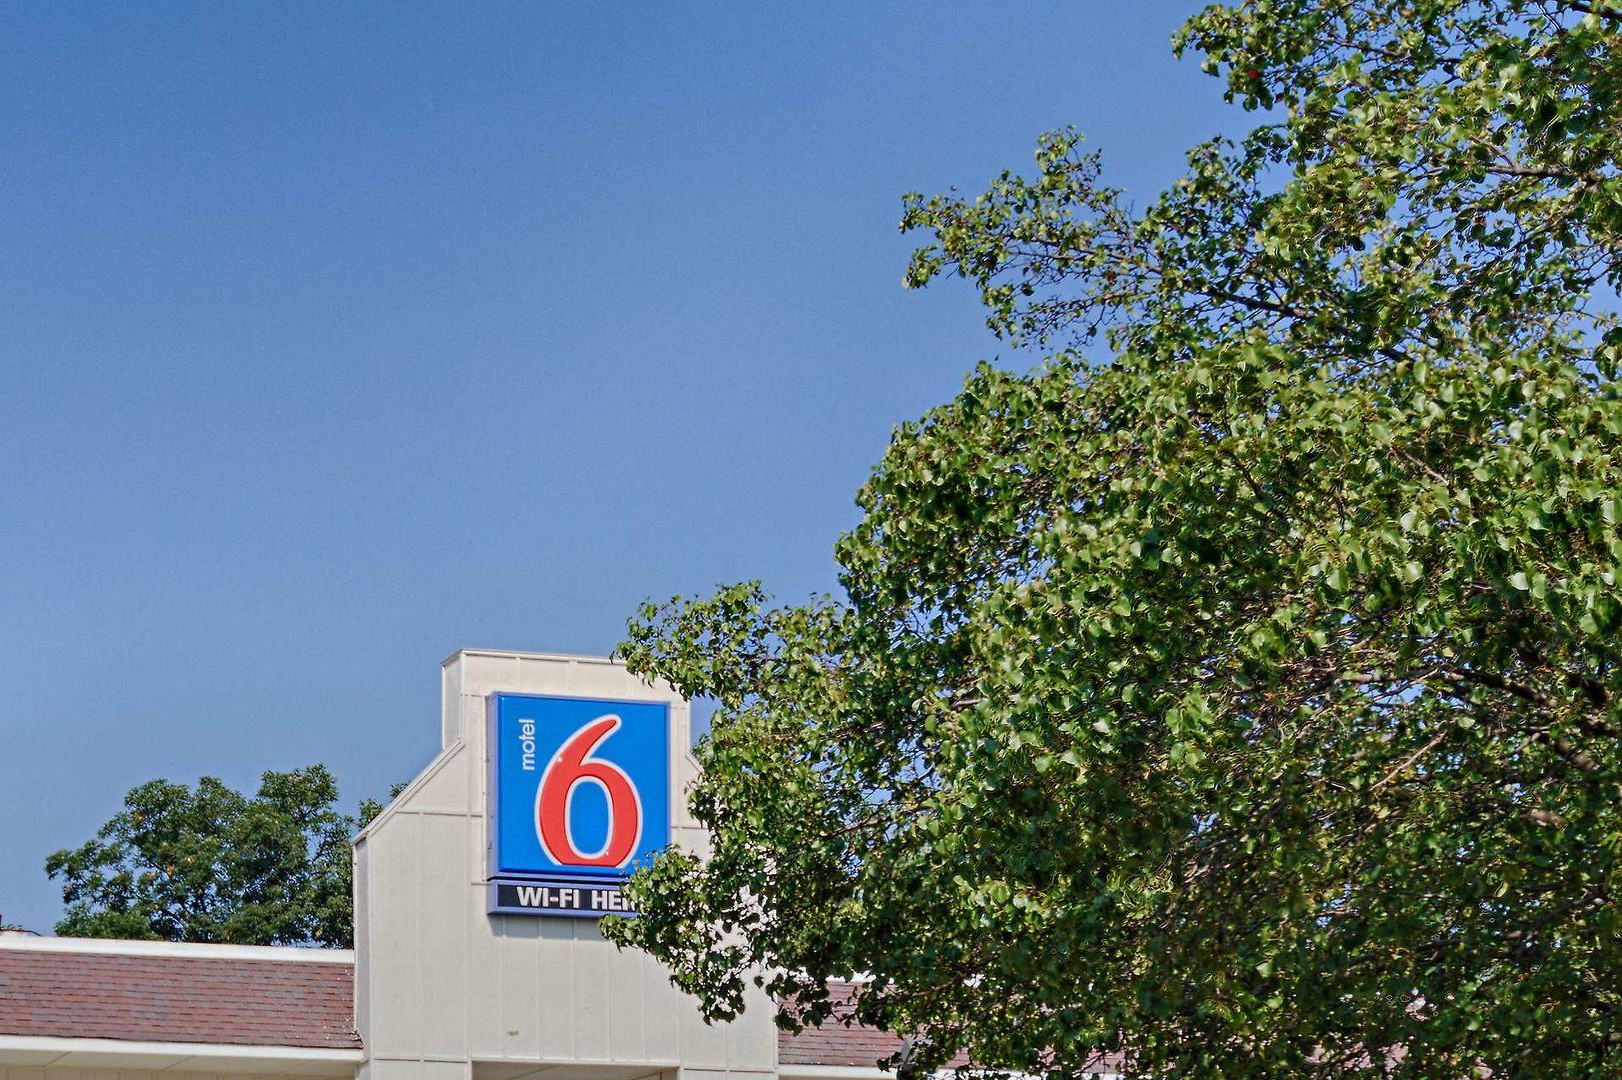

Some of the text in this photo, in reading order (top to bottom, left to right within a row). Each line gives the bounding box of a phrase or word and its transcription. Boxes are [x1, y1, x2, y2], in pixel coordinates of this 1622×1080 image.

[517, 718, 535, 771] motel
[534, 713, 643, 868] 6
[516, 886, 636, 911] WI-FI HE
